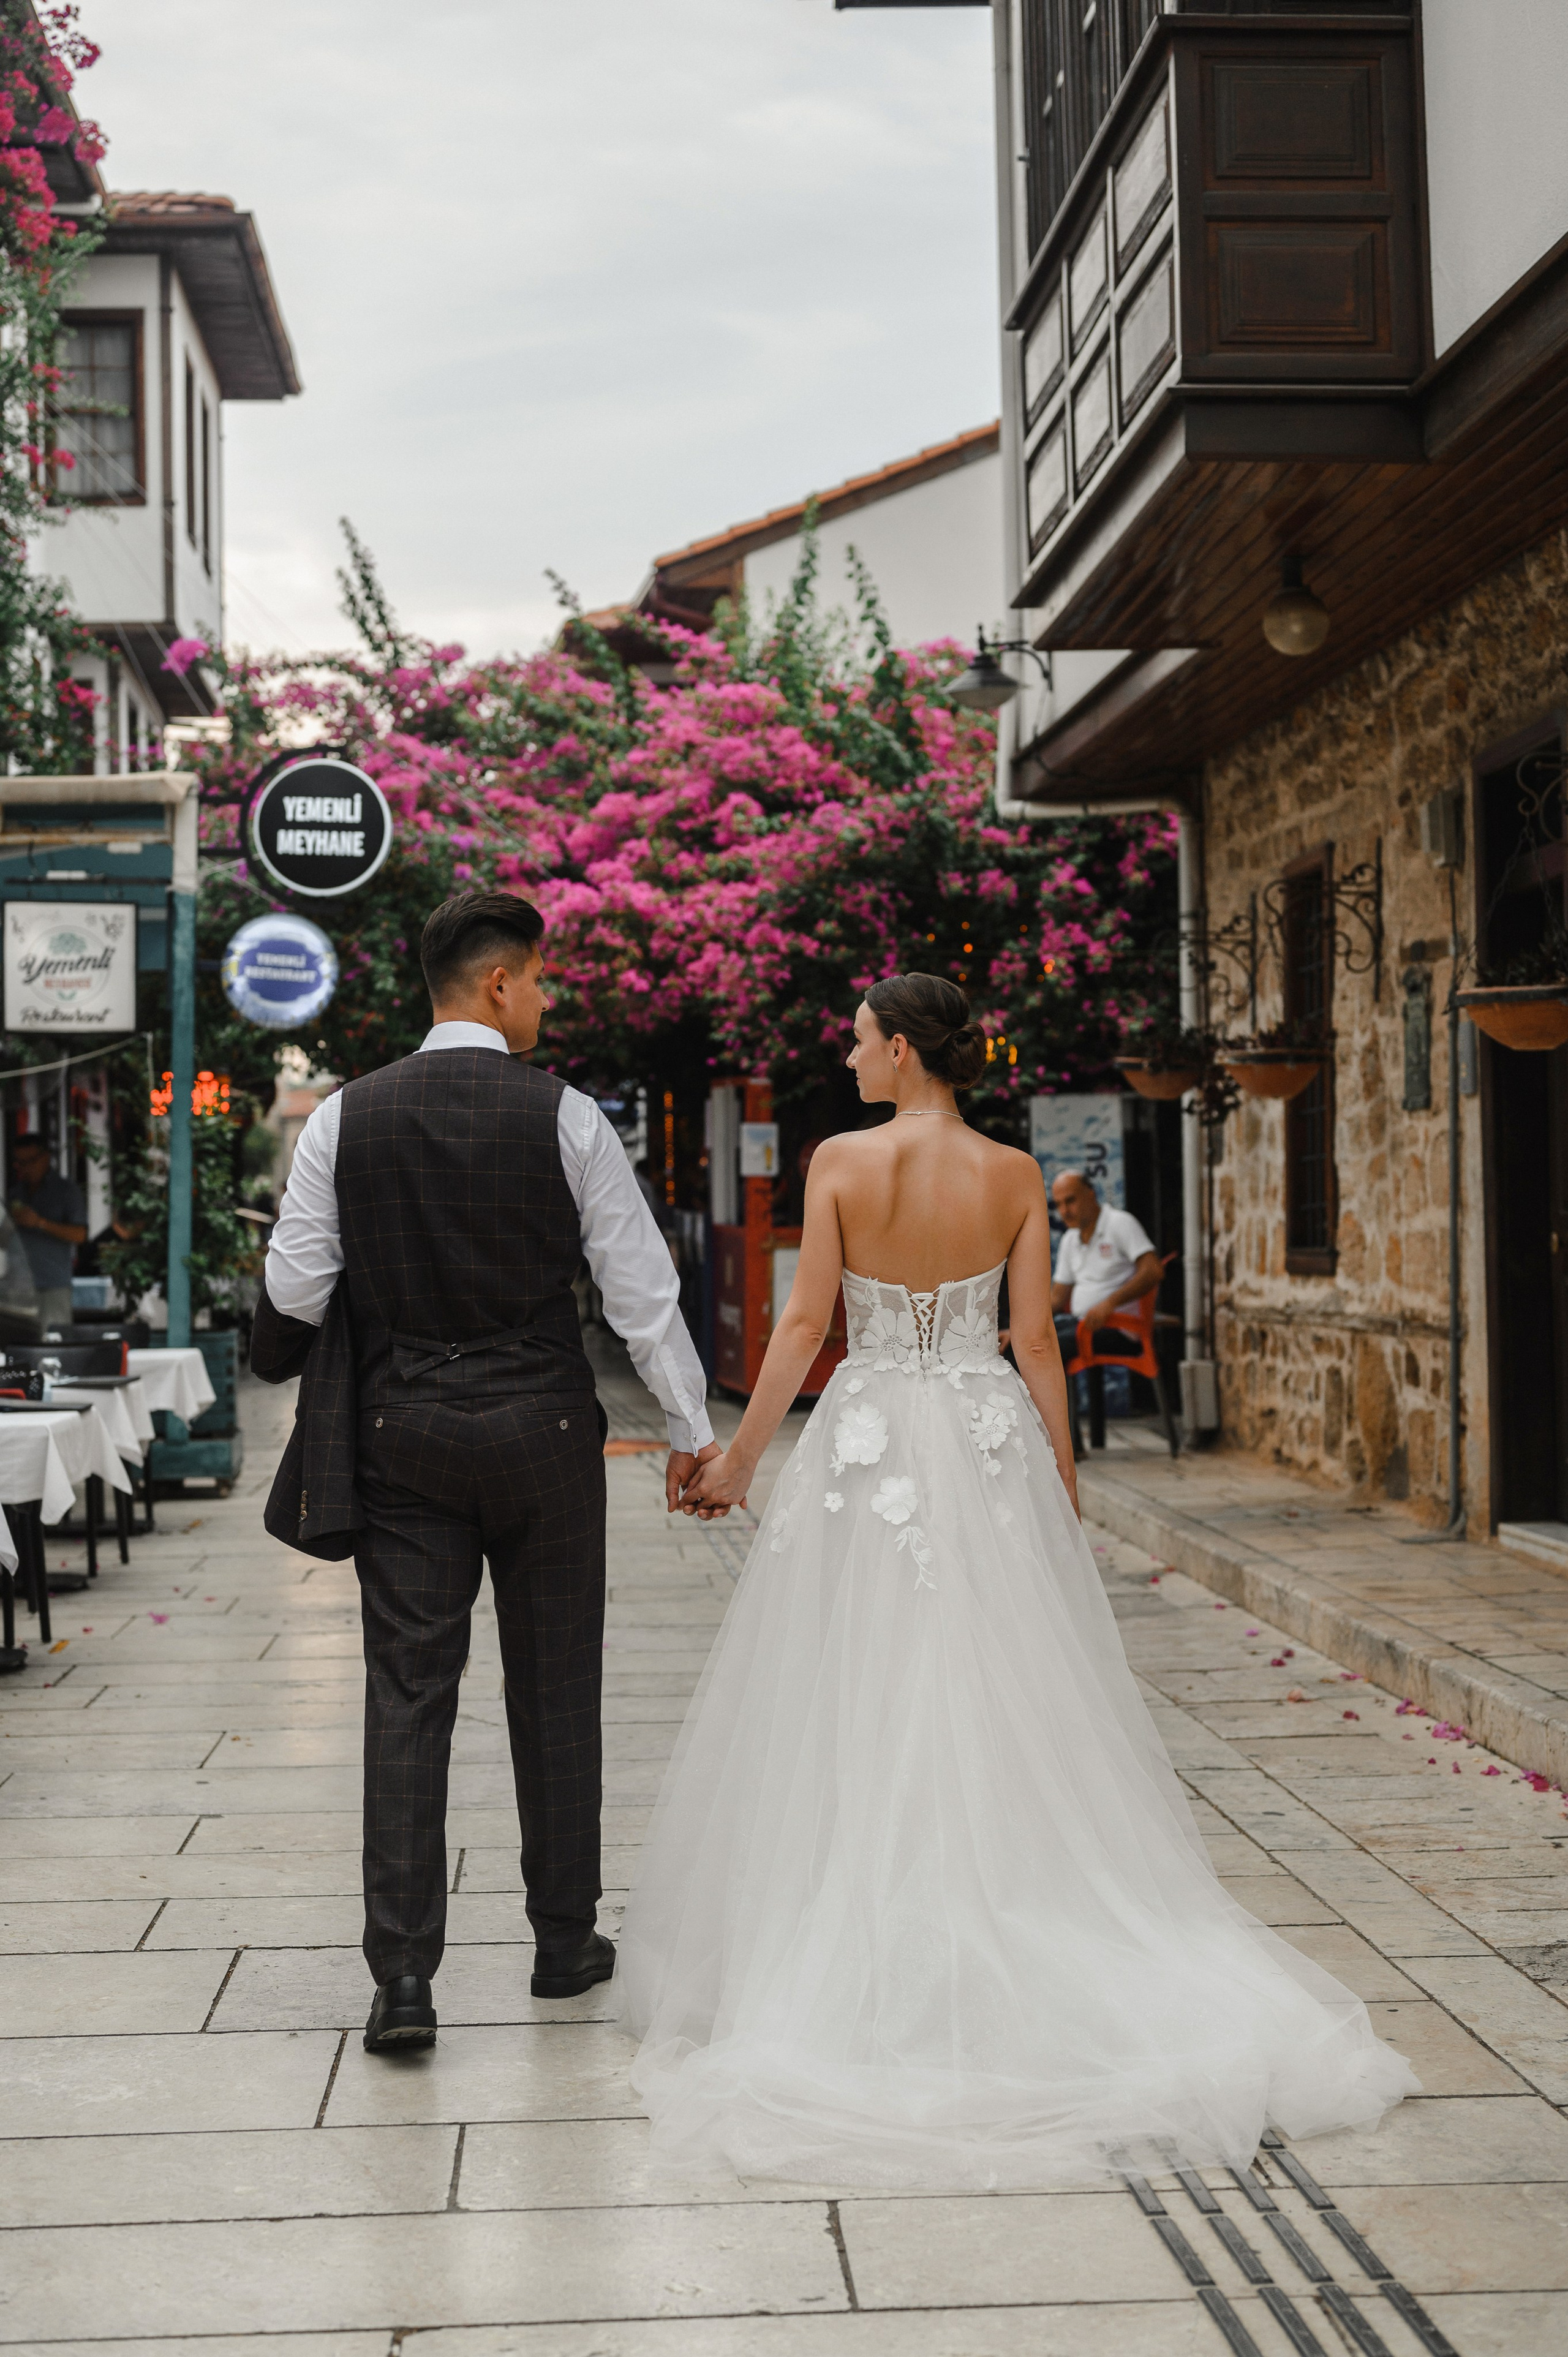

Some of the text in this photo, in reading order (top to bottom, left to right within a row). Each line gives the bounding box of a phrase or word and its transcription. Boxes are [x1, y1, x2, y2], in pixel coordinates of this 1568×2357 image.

[282, 793, 363, 823] YEMENLİ
[277, 829, 366, 857] MEYHANE
[18, 948, 116, 986] Yemenli
